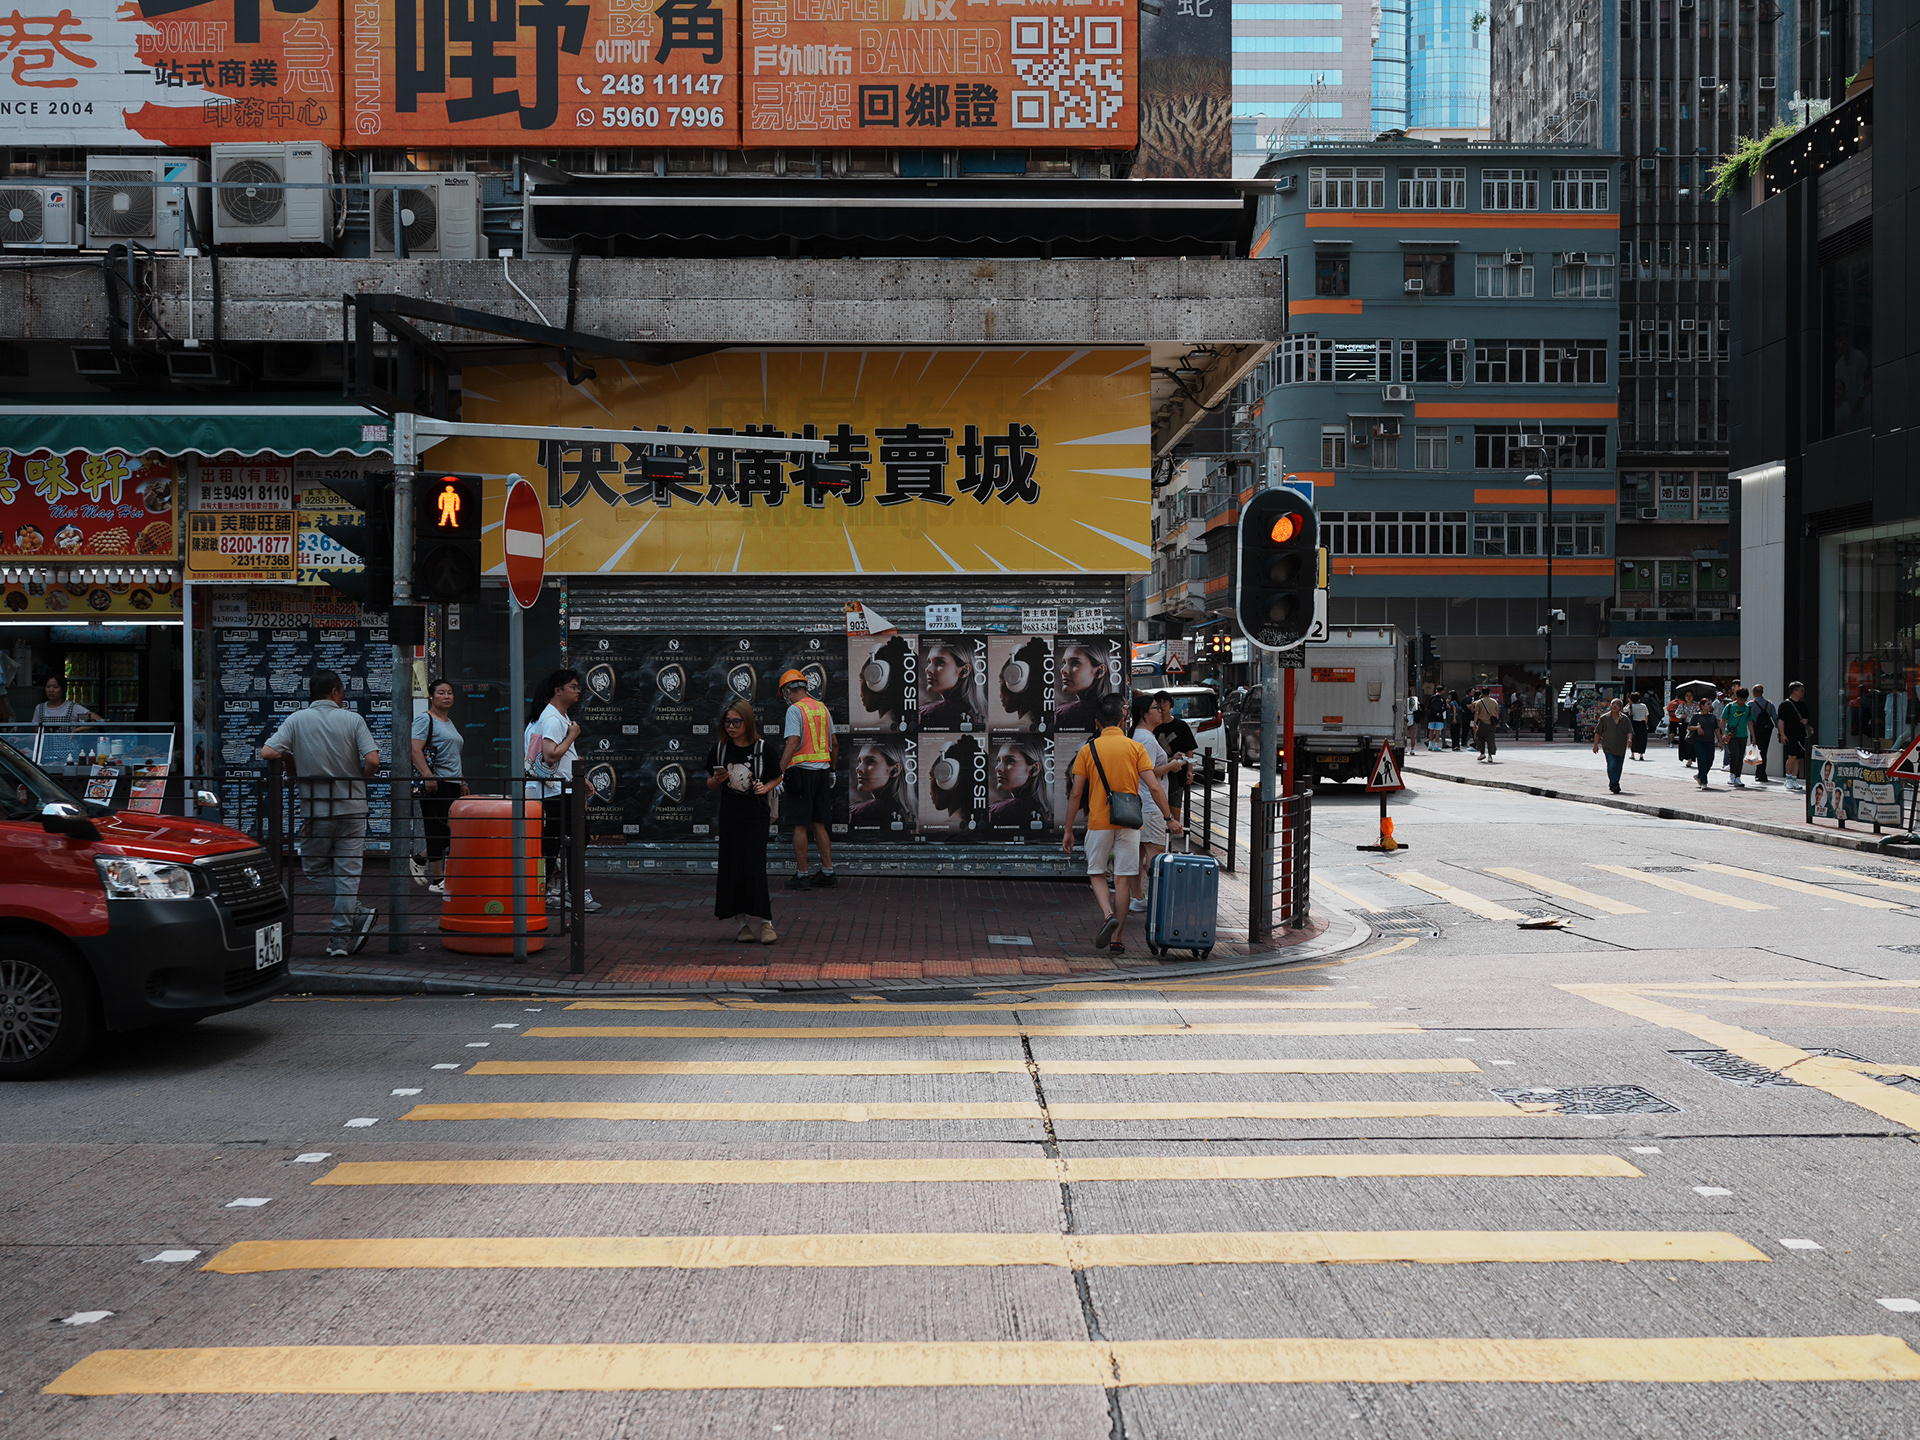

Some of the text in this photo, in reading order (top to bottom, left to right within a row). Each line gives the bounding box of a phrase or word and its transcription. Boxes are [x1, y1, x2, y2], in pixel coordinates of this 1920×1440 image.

[609, 13, 654, 36] B4
[654, 0, 723, 64] 角
[142, 22, 227, 53] BOOKLET
[283, 18, 334, 94] 急
[595, 39, 650, 63] OUTPUT
[859, 28, 1003, 74] BANNER
[124, 59, 278, 88] 一站式商業
[354, 0, 381, 135] RINTING
[601, 74, 724, 95] 248 11147
[49, 102, 93, 114] 2004
[202, 97, 328, 127] 印務中心
[602, 106, 724, 127] 5960 7996
[752, 82, 851, 131] 易拉架
[858, 83, 999, 128] 回鄉證
[537, 423, 1041, 508] 快樂購特賣城
[224, 485, 253, 500] 9491
[259, 485, 289, 500] 8110
[304, 496, 326, 504] 9283
[49, 504, 144, 522] Mei May Hin
[220, 536, 289, 554] 8200-1877
[314, 554, 336, 564] For
[313, 604, 356, 615] 55486228
[224, 630, 250, 638] LAB
[272, 630, 299, 638] LAB
[320, 630, 347, 638] LAB
[1022, 623, 1057, 632] 9683 5434
[1068, 622, 1103, 633] 9683 5434
[903, 638, 917, 711] P100 SE
[974, 639, 987, 686] A100
[1108, 639, 1122, 686] A100
[224, 701, 251, 709] LAB
[274, 701, 301, 709] LAB
[1043, 687, 1055, 711] SE
[905, 738, 917, 785] A100
[973, 737, 986, 809] P100 SE
[258, 943, 281, 967] 5430
